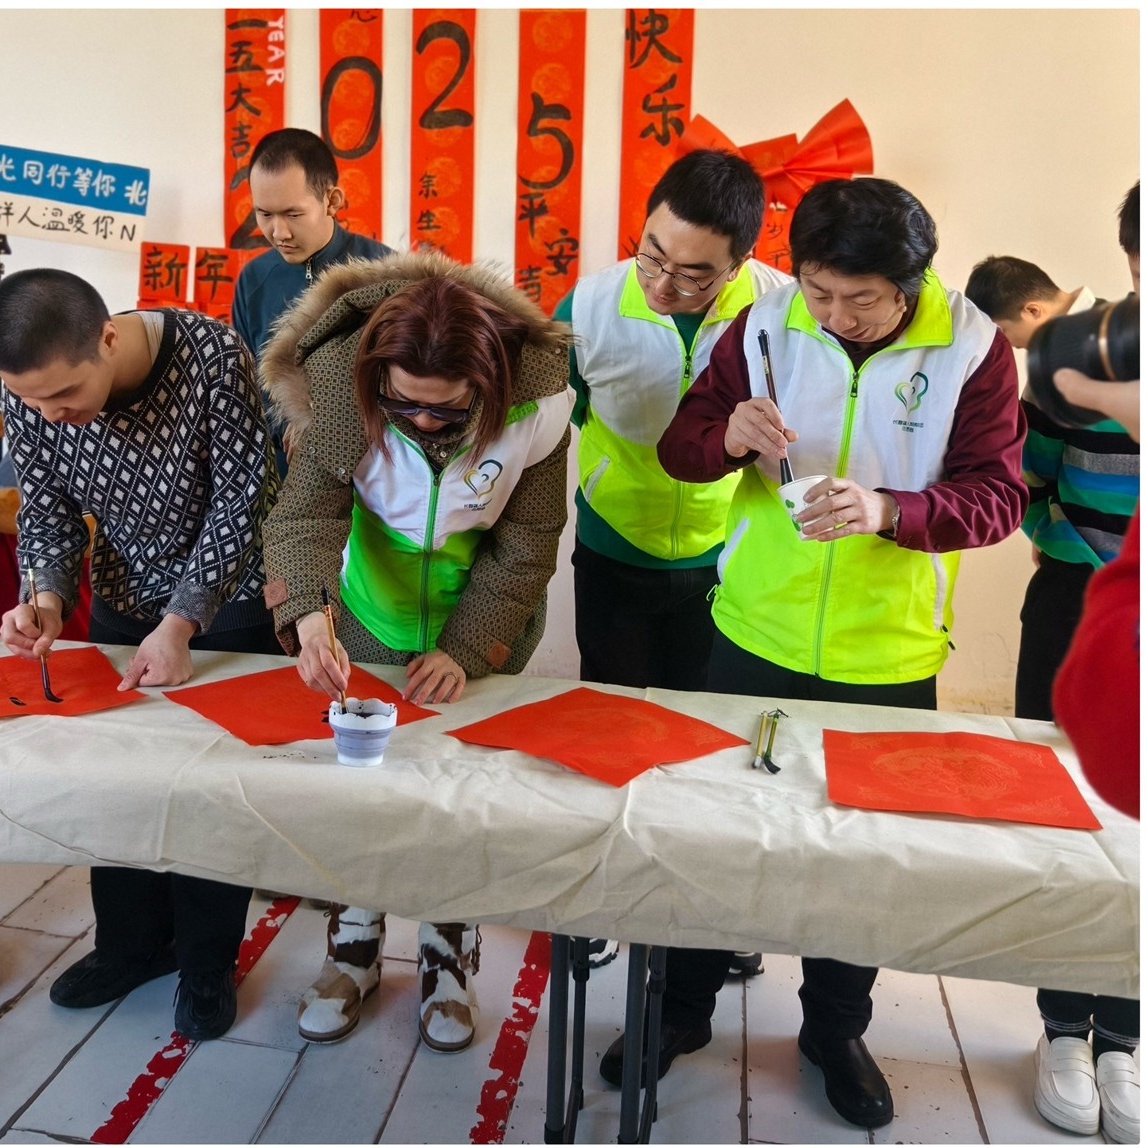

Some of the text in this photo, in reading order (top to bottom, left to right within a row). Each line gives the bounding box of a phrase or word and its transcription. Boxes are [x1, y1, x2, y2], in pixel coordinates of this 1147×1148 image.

[264, 16, 285, 86] YEAR
[416, 20, 474, 130] 2
[625, 9, 685, 147] 快乐
[518, 92, 575, 190] 5
[120, 224, 136, 241] N
[124, 180, 147, 206] 北
